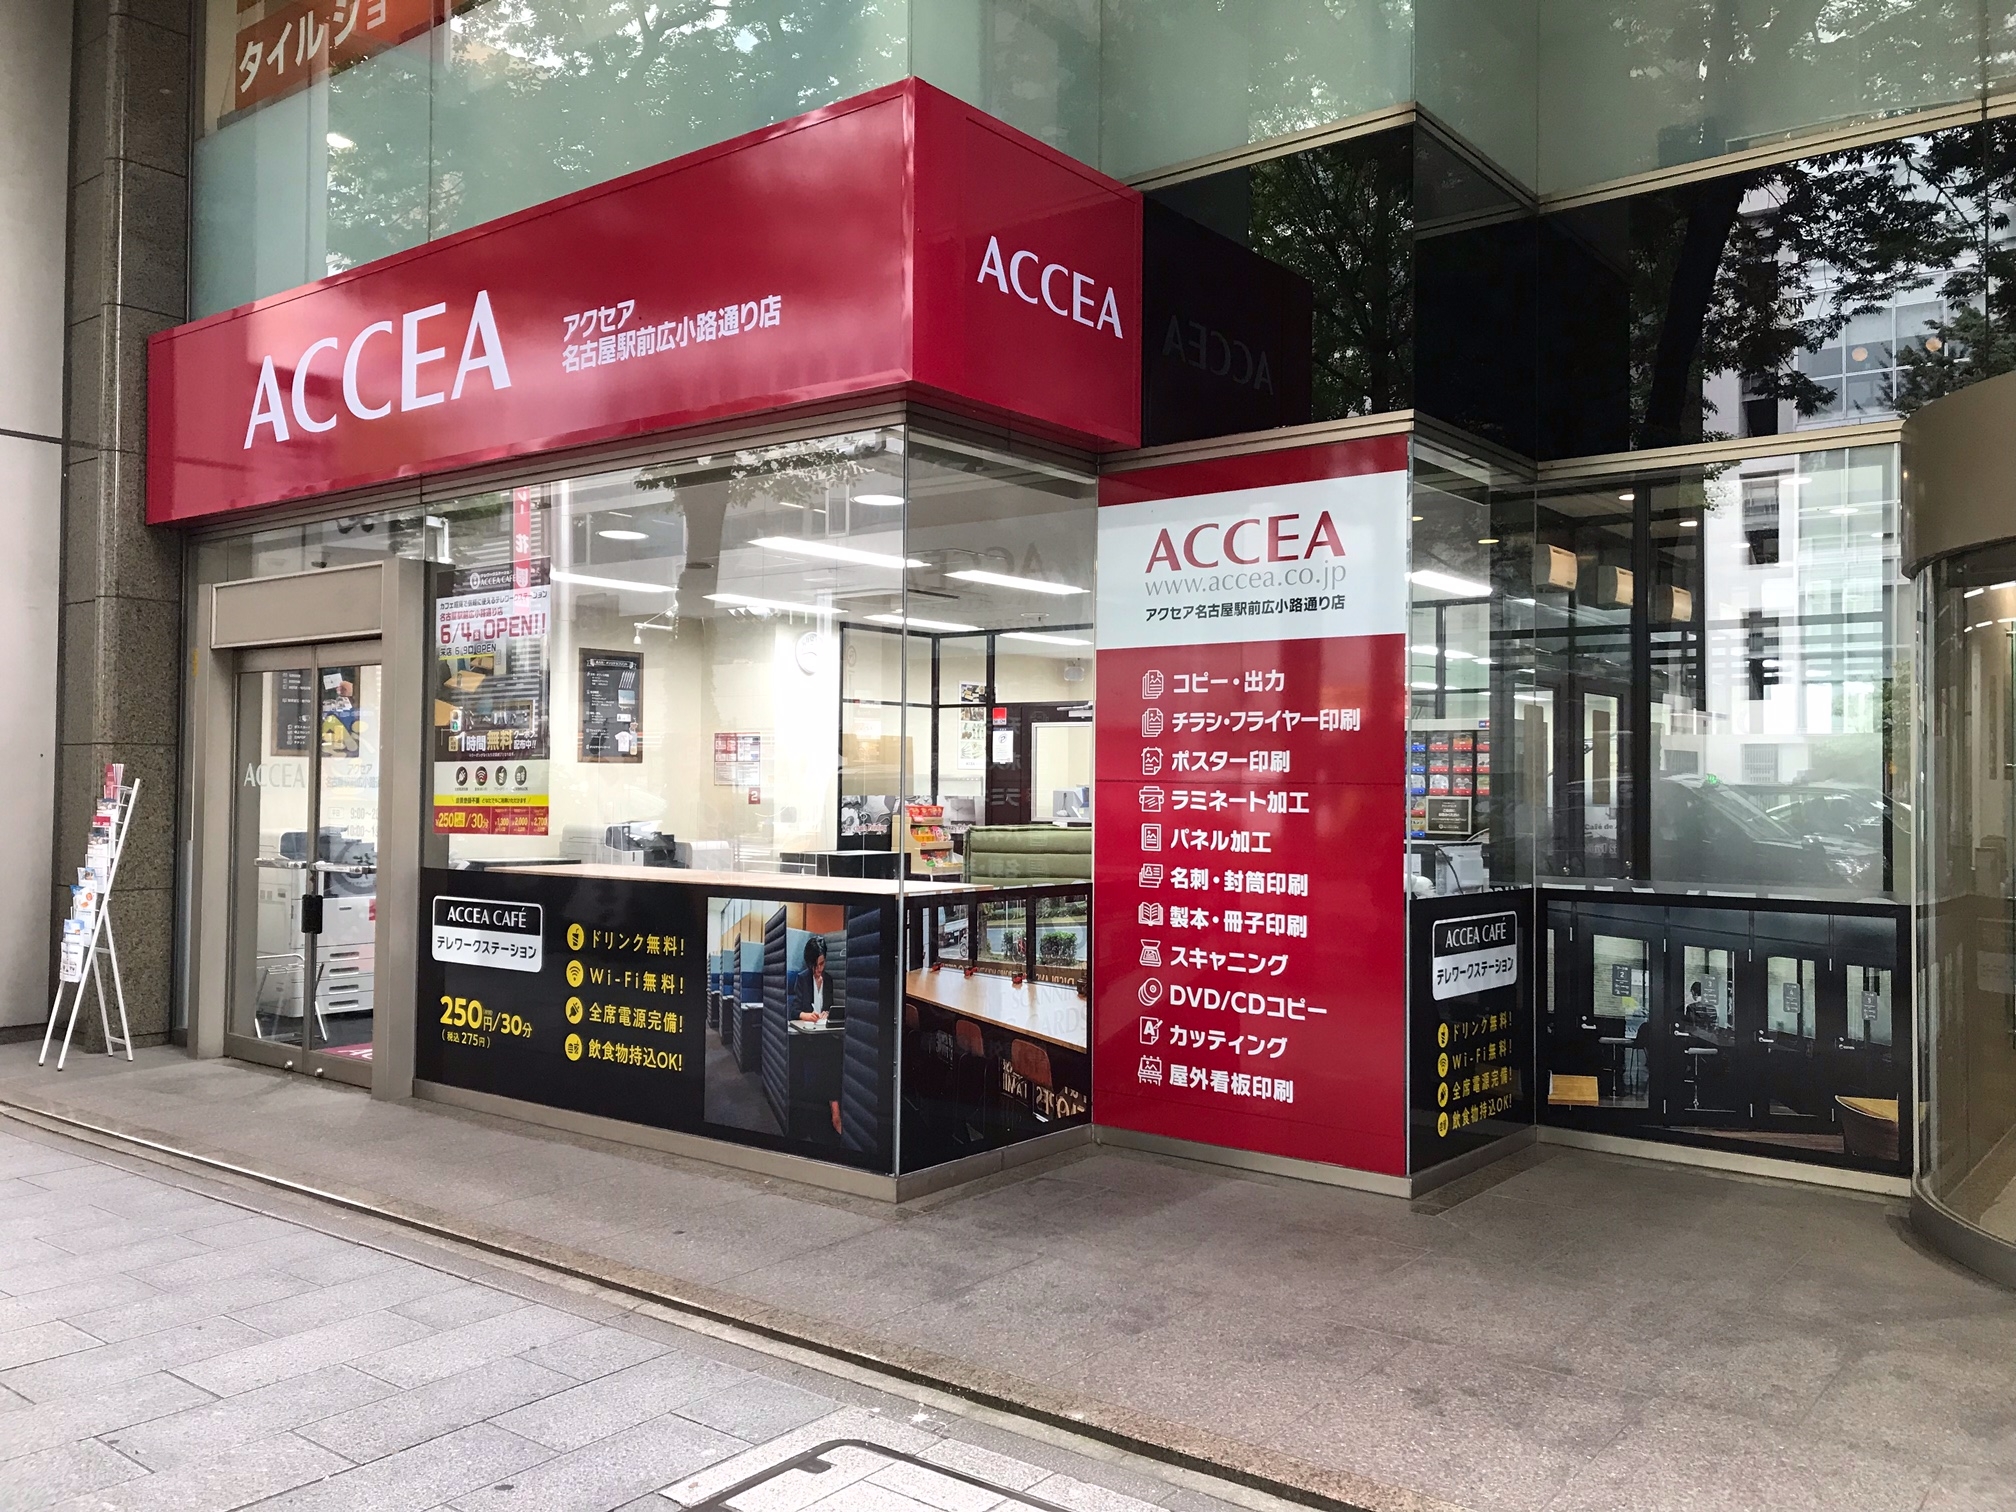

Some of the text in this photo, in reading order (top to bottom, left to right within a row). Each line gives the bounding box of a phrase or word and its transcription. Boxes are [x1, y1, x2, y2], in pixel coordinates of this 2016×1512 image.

[977, 235, 1124, 339] ACCEA
[562, 294, 782, 374] 名古屋駅前広小路通り店
[563, 299, 635, 343] アクセア
[243, 290, 512, 450] ACCEA
[1145, 510, 1347, 574] ACCEA
[1145, 560, 1347, 596] www.accea.co.jp
[1145, 594, 1346, 622] アクセア名古屋駅前広小路通り店
[483, 612, 546, 640] OPEN!!
[1172, 669, 1286, 694] コピー・出力
[1171, 707, 1361, 733] チラシ・フライヤー印刷
[243, 762, 305, 788] ACCEA
[1171, 750, 1291, 773] ポスター印刷
[1171, 789, 1310, 814] ラミネート加工
[1170, 828, 1272, 854] パネル加工
[1170, 866, 1309, 897] 名刺・封筒印刷
[447, 905, 527, 929] ACCEA CAFÉ
[1170, 905, 1308, 939] 製本・冊子印刷
[1445, 916, 1507, 948] ACCEA CAFÉ
[436, 935, 537, 960] テレワークステーション
[1170, 945, 1289, 976] スキャニング
[1437, 956, 1514, 986] テレワークステーション
[1170, 984, 1328, 1021] DVD/CDコピー
[1170, 1024, 1288, 1059] カッティング
[1170, 1063, 1294, 1104] 屋外看板印刷
